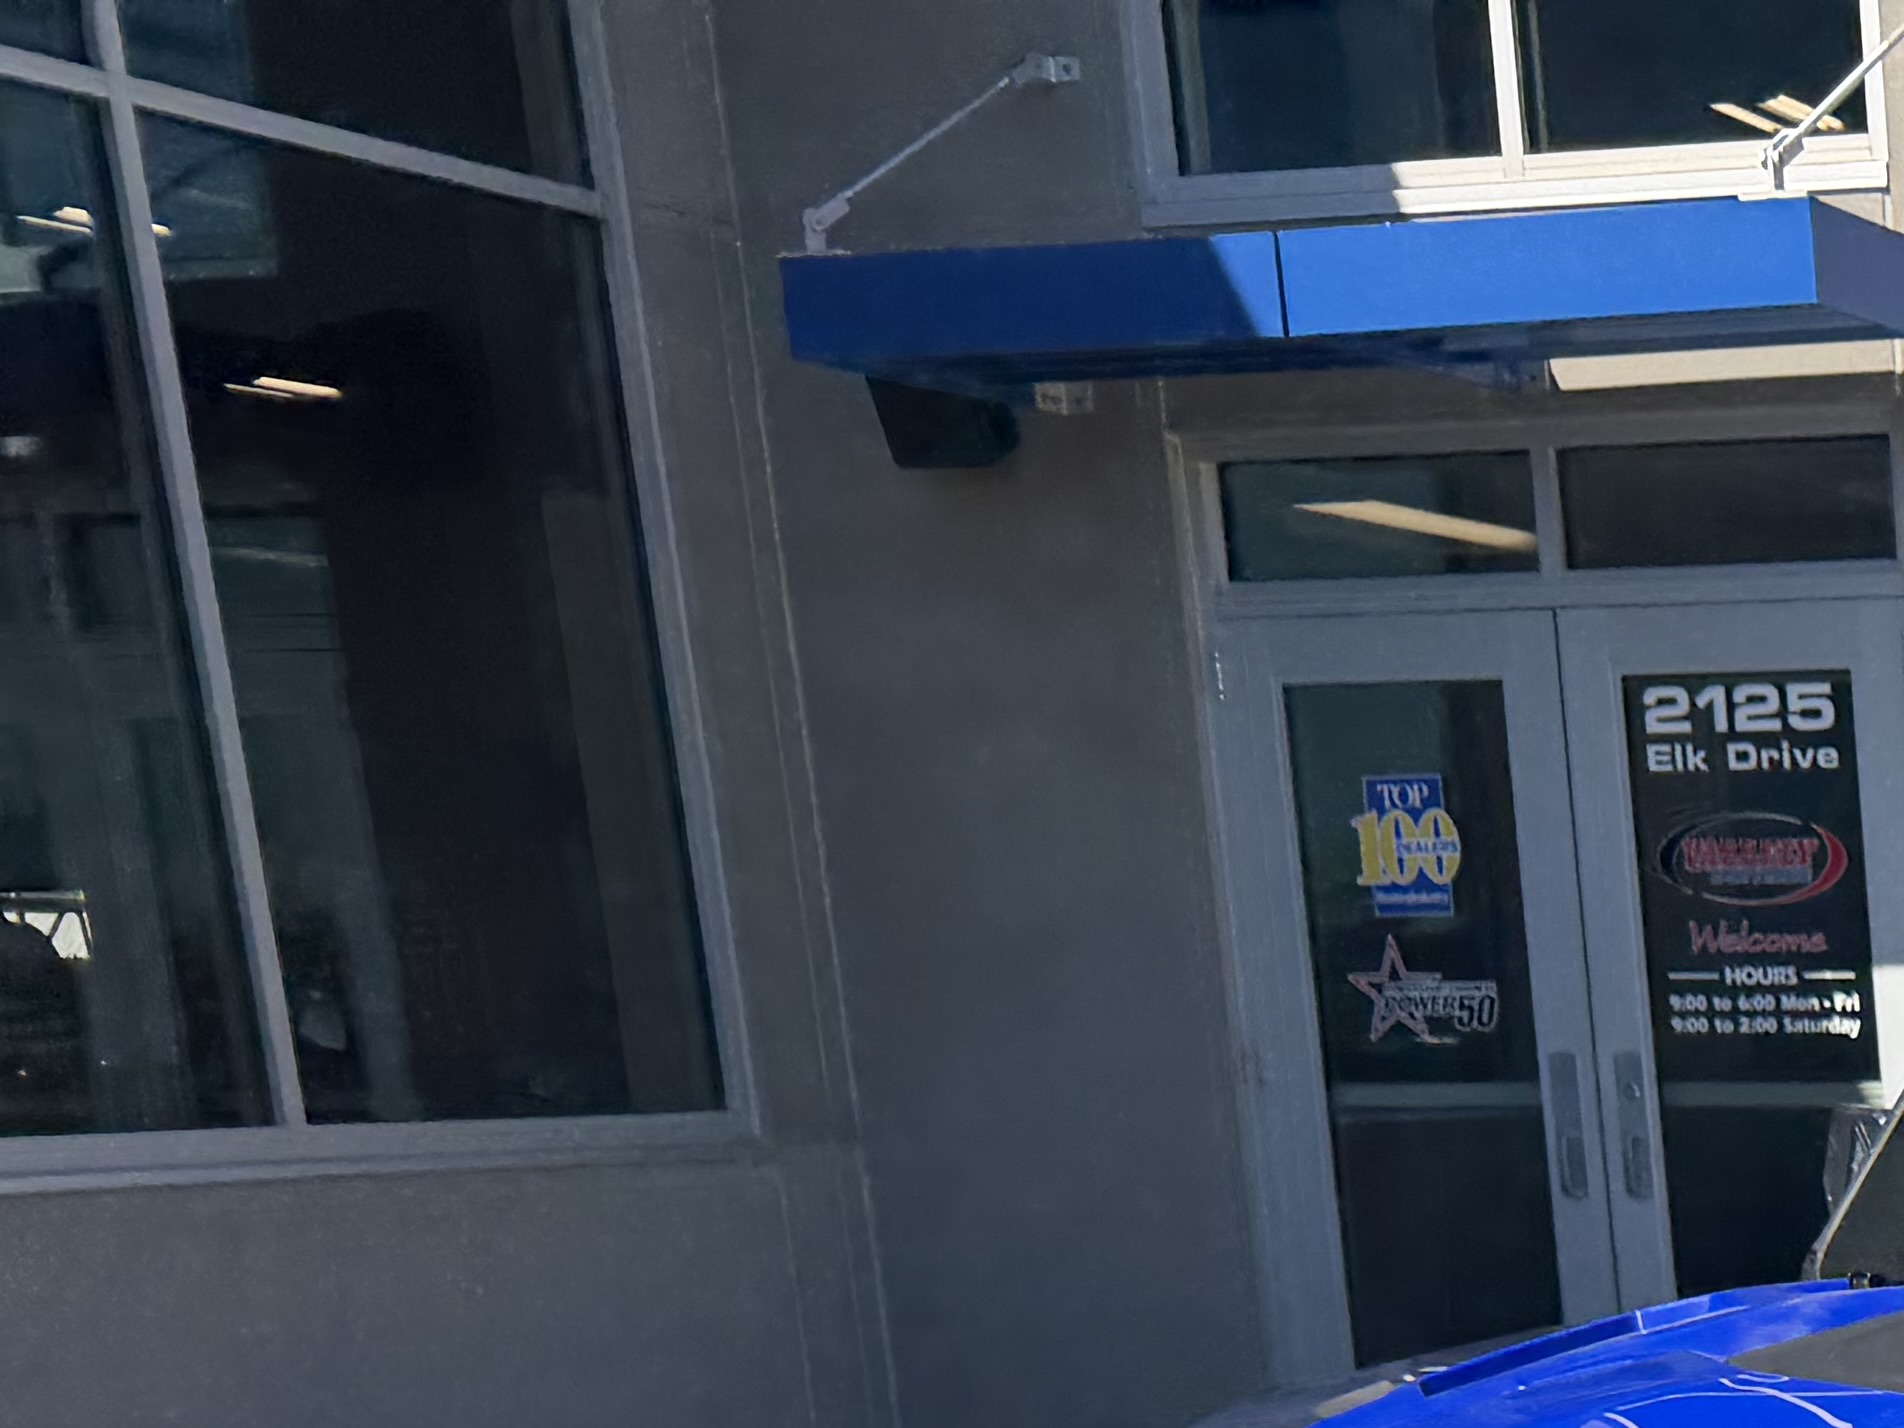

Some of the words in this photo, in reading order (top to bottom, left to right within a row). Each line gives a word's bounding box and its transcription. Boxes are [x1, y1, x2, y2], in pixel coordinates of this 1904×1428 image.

[1643, 682, 1836, 734] 2125
[1646, 742, 1710, 773] Elk
[1726, 739, 1840, 772] Drive
[1377, 781, 1429, 809] TOP
[1351, 807, 1462, 886] 100
[1689, 918, 1829, 956] Welcome
[1724, 965, 1799, 987] HOURS
[1454, 994, 1498, 1032] 50
[1669, 993, 1708, 1012] 9:00
[1712, 995, 1733, 1012] to
[1780, 993, 1820, 1012] Mon
[1833, 991, 1861, 1013] Fri
[1670, 1016, 1709, 1034] 9:00
[1714, 1017, 1735, 1034] to
[1738, 1016, 1778, 1035] 2:00
[1782, 1014, 1862, 1040] Saturday
